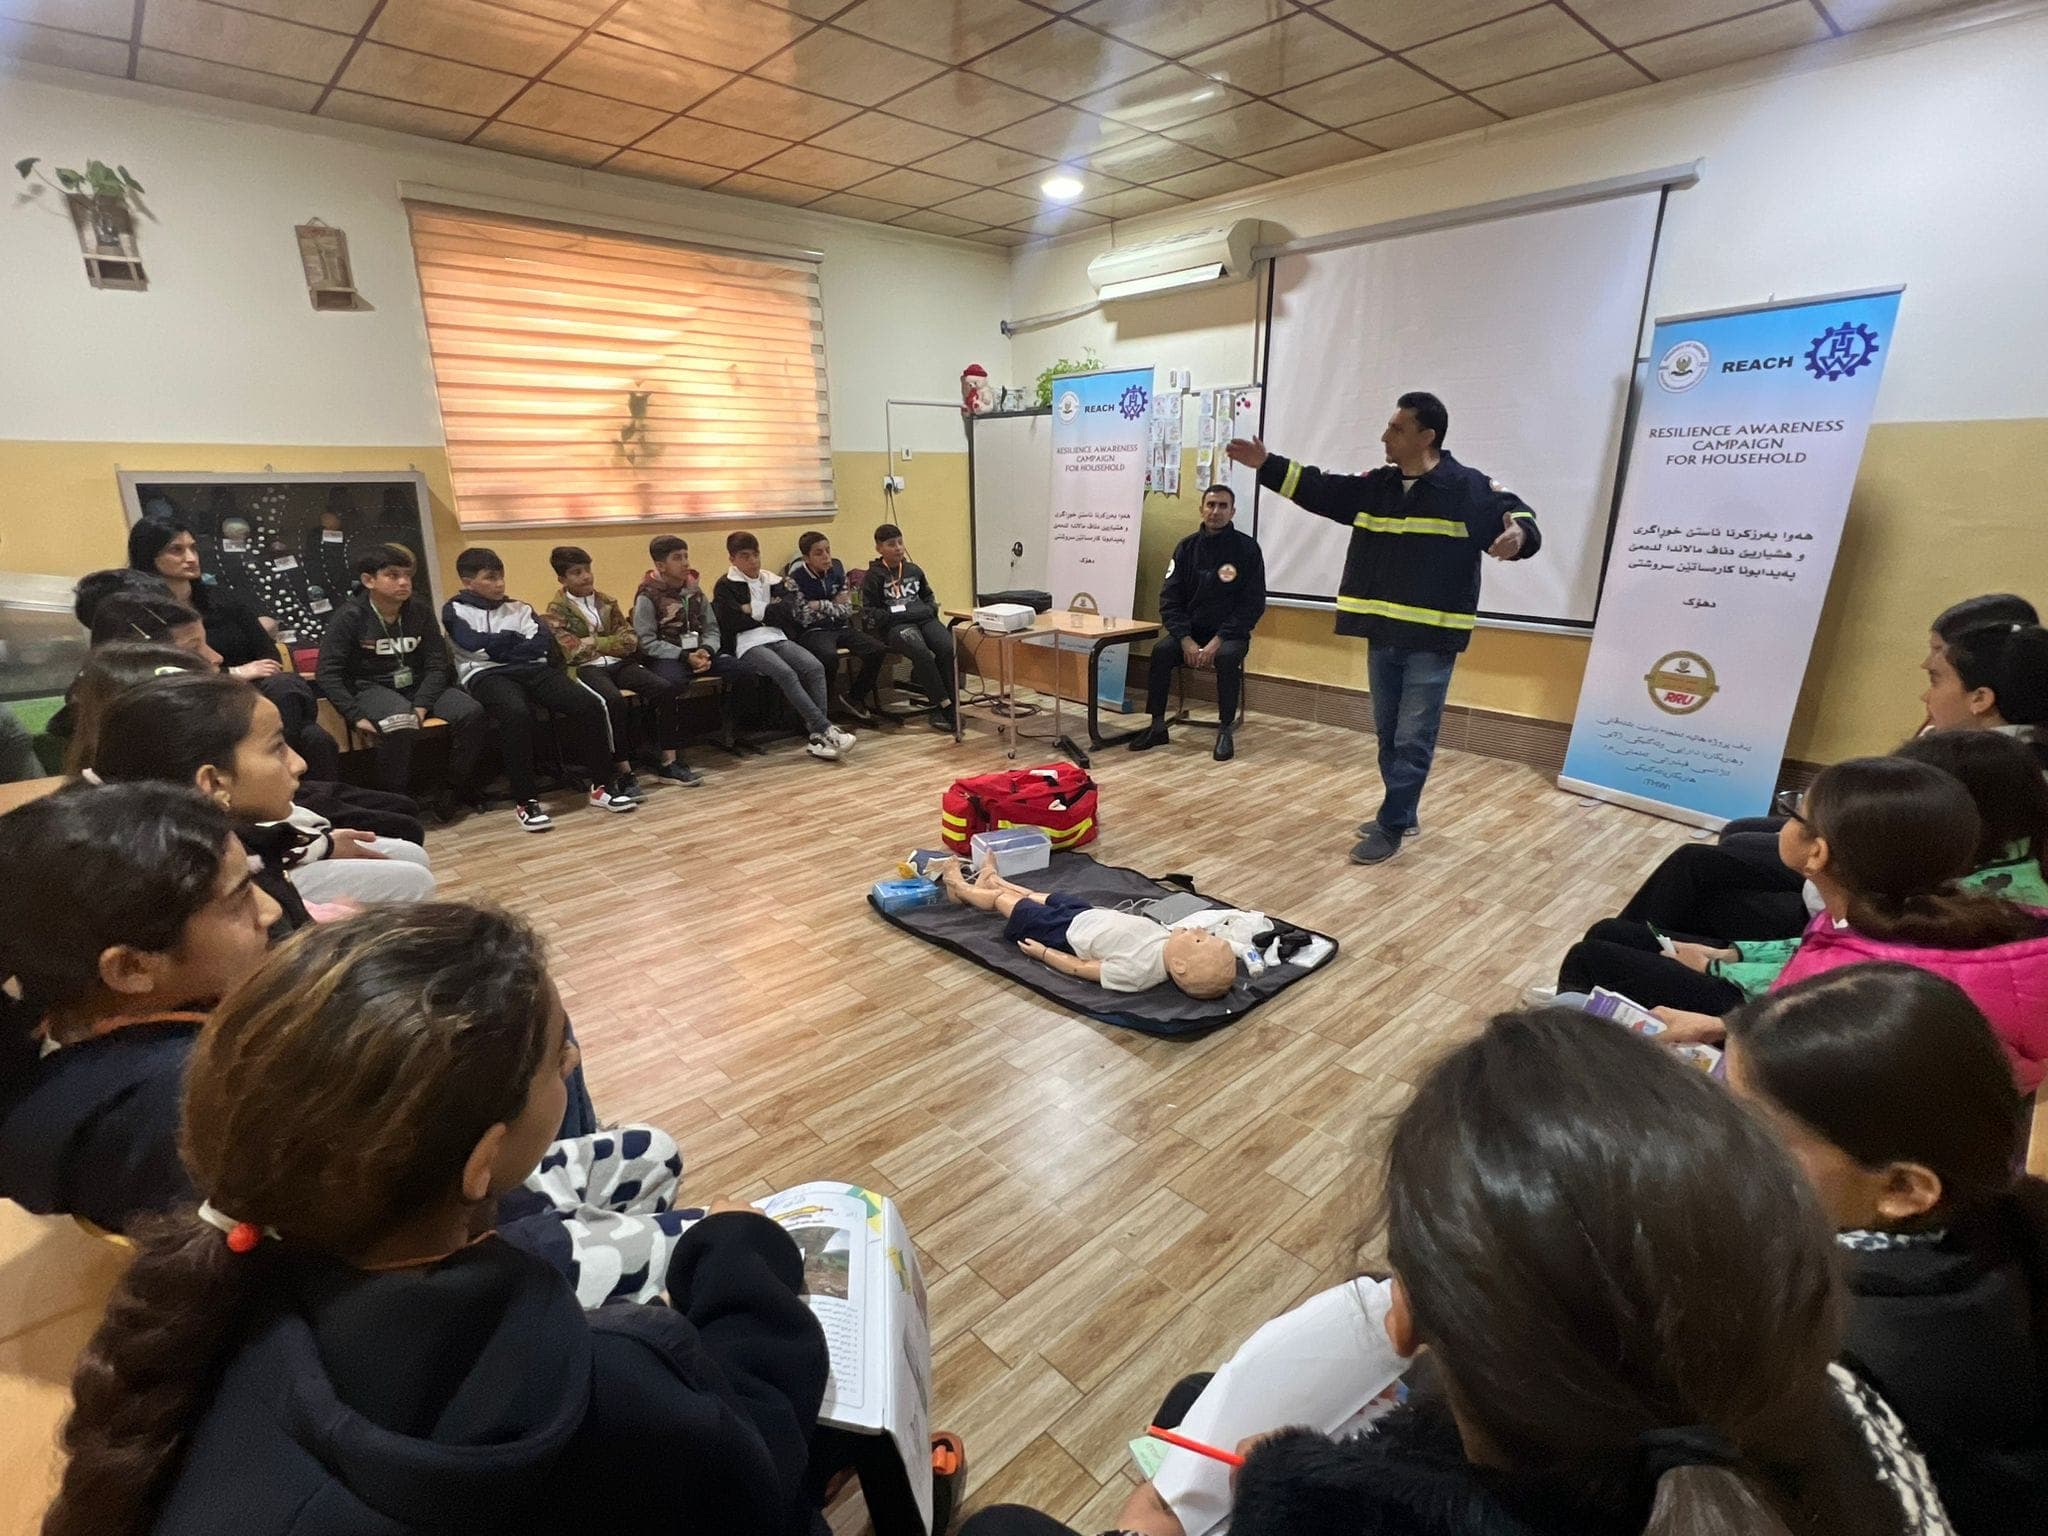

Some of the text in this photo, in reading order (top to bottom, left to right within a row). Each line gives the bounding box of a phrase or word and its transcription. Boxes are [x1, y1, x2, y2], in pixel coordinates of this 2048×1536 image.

[1721, 356, 1794, 374] REACH
[1084, 403, 1115, 414] REACH
[1648, 419, 1845, 439] RESILIENCE AWARENESS
[1056, 443, 1138, 455] RESILIENCE AWARENESS
[1692, 438, 1785, 452] CAMPAIGN
[1076, 454, 1116, 463] CAMPAIGN
[1665, 451, 1807, 466] FOR HOUSEHOLD
[1065, 463, 1125, 473] FOR HOUSEHOLD
